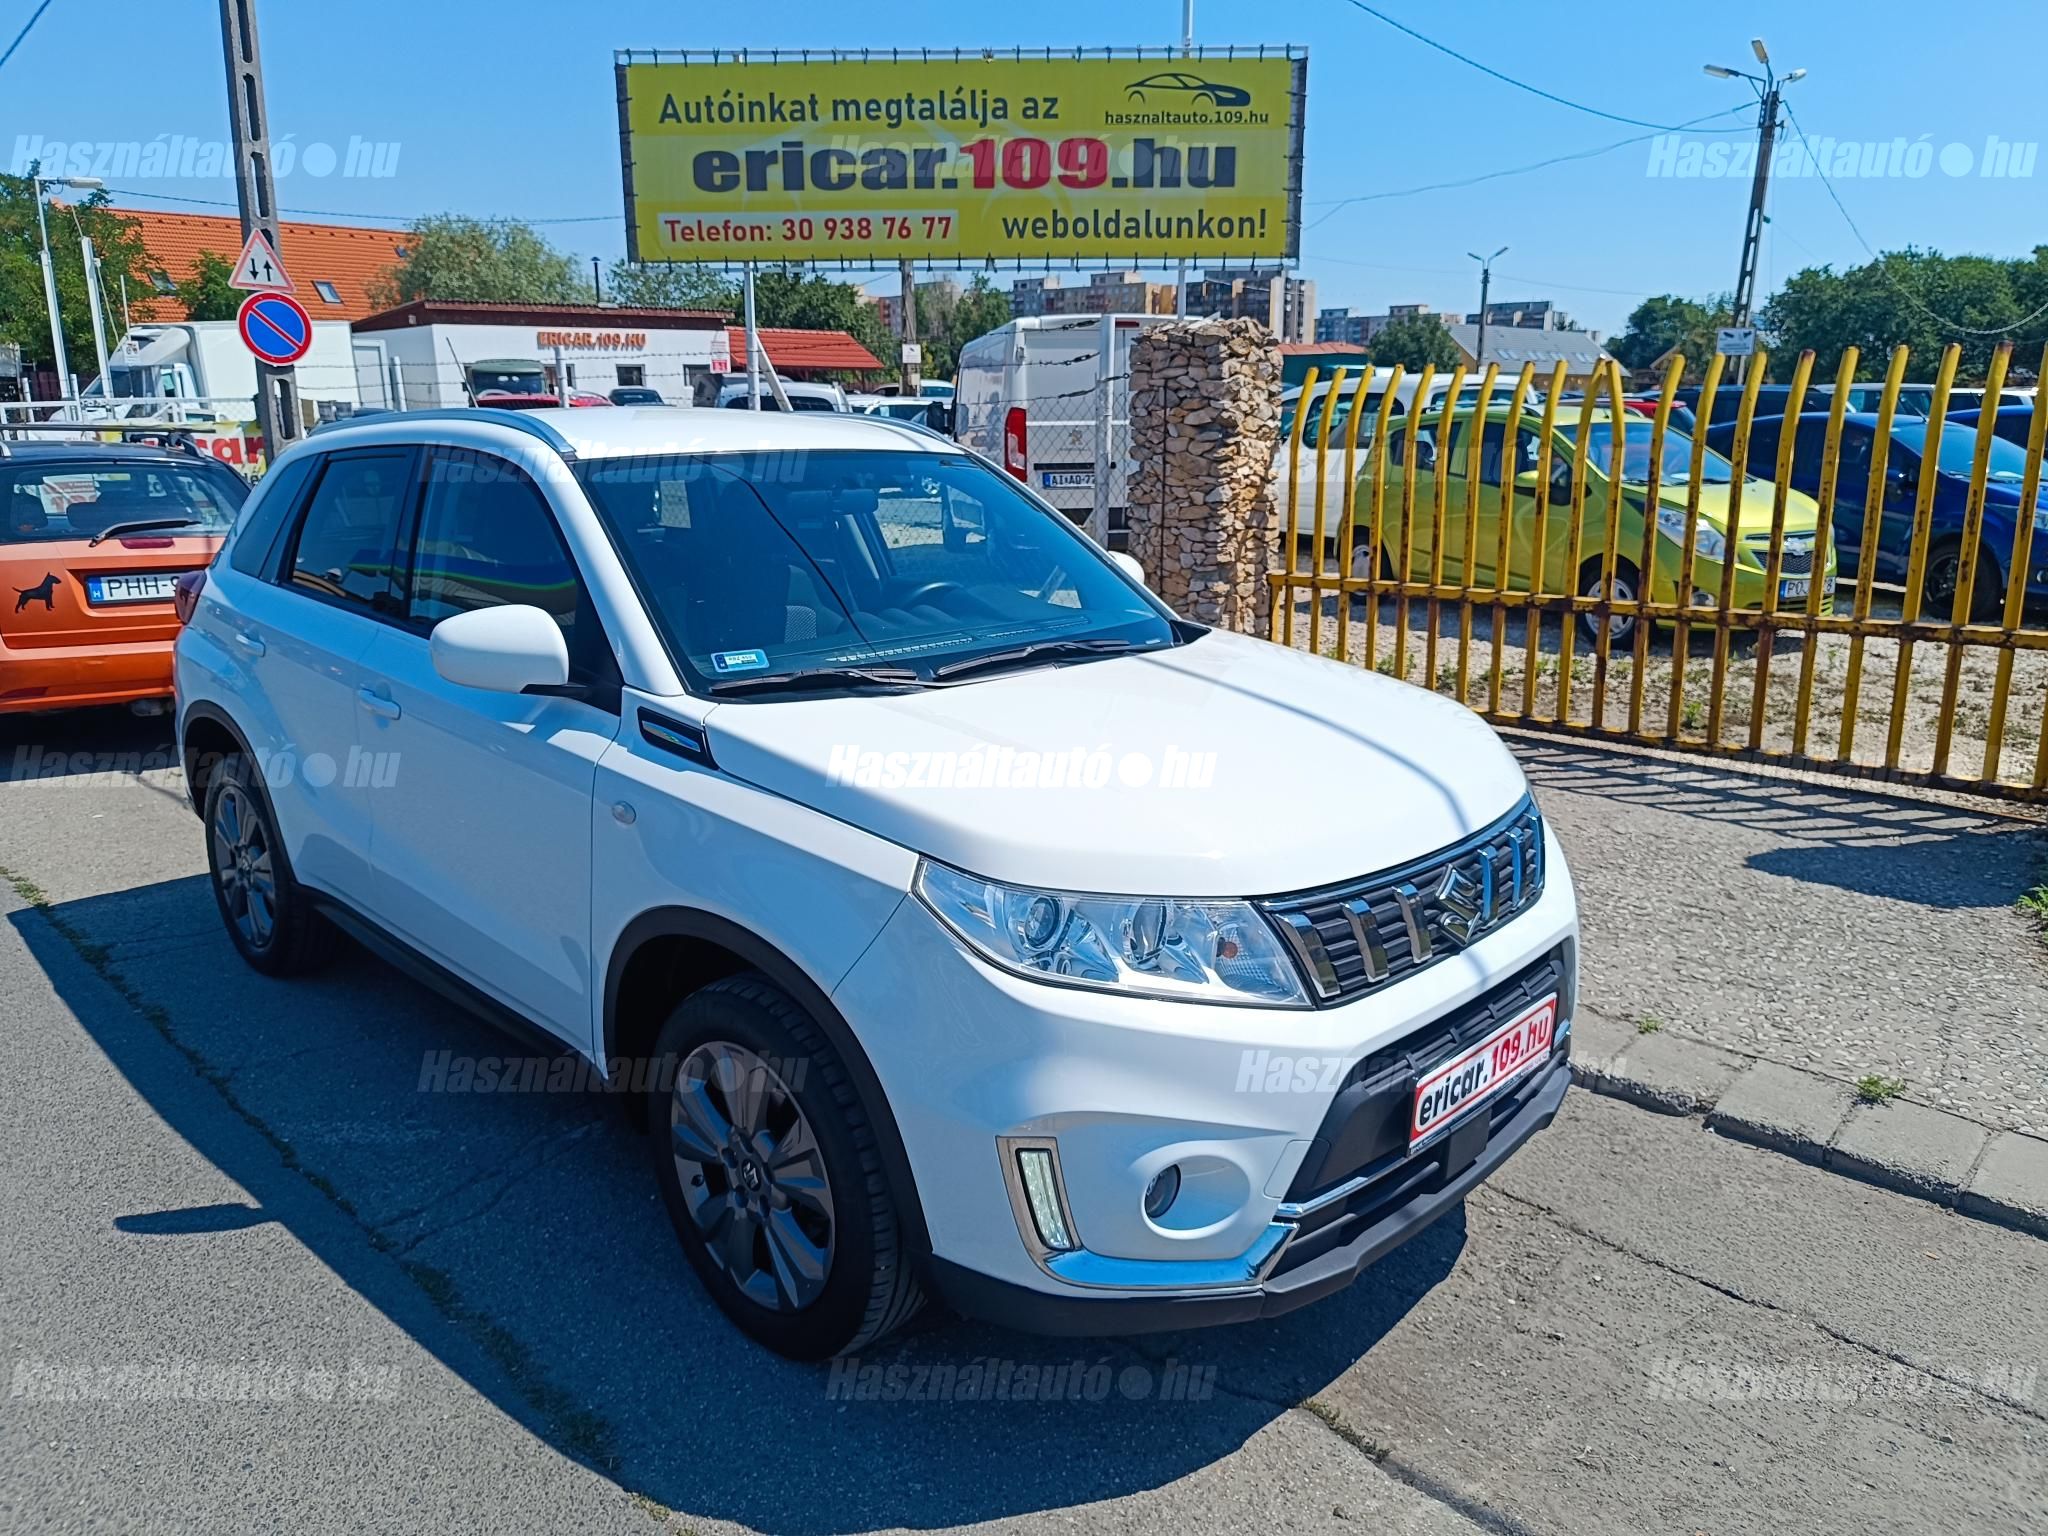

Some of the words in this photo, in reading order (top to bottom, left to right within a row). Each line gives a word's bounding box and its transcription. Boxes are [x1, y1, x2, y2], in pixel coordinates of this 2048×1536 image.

[659, 89, 819, 124] Autóinkat
[832, 86, 1008, 128] megtalálja
[1022, 96, 1060, 120] az
[1105, 111, 1269, 125] hasznaltauto.109.hu
[693, 137, 1237, 193] ericar.109.hu
[664, 219, 772, 242] Telefon:
[782, 218, 813, 241] 30
[824, 217, 872, 240] 938
[882, 216, 911, 239] 76
[922, 215, 951, 239] 77
[1002, 208, 1267, 239] weboldalunkon!
[1419, 1016, 1549, 1126] ericar.109.hu
